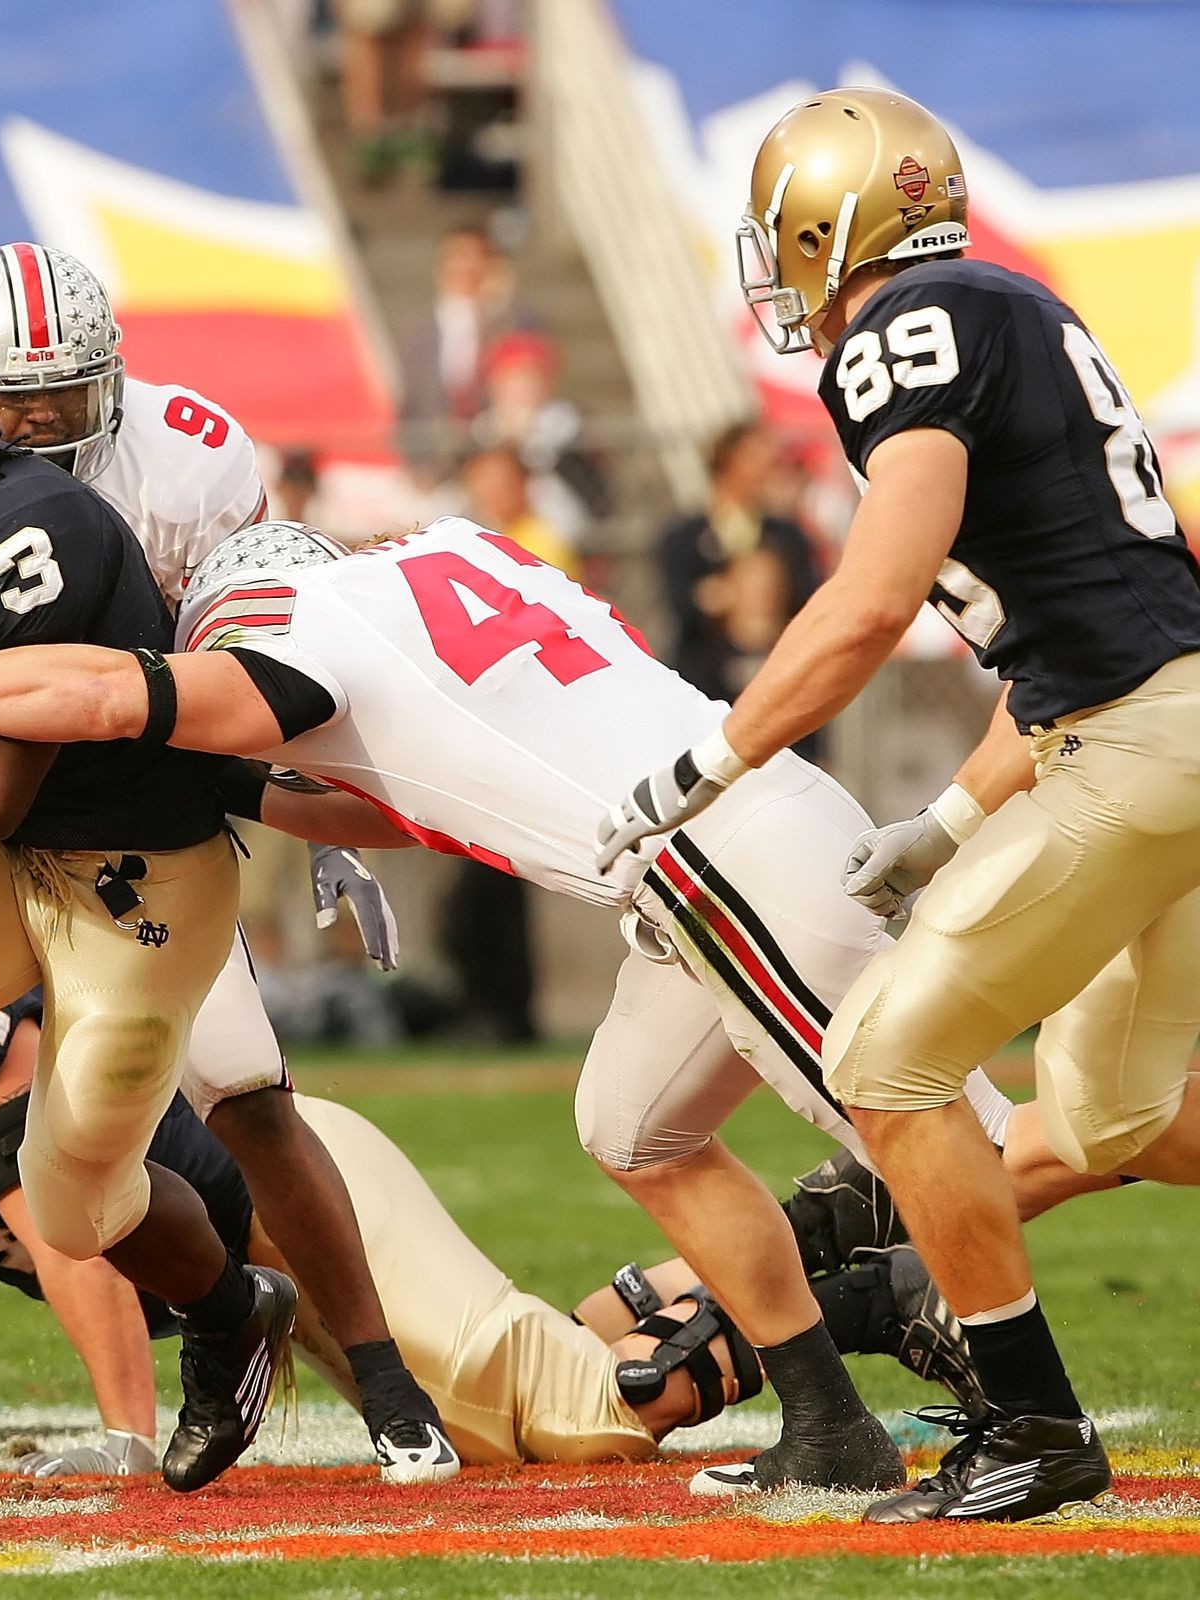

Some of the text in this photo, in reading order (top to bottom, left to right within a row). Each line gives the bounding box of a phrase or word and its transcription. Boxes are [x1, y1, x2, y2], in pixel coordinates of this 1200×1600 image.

[912, 231, 967, 248] IRISH
[836, 305, 960, 423] 89
[164, 396, 229, 448] 9
